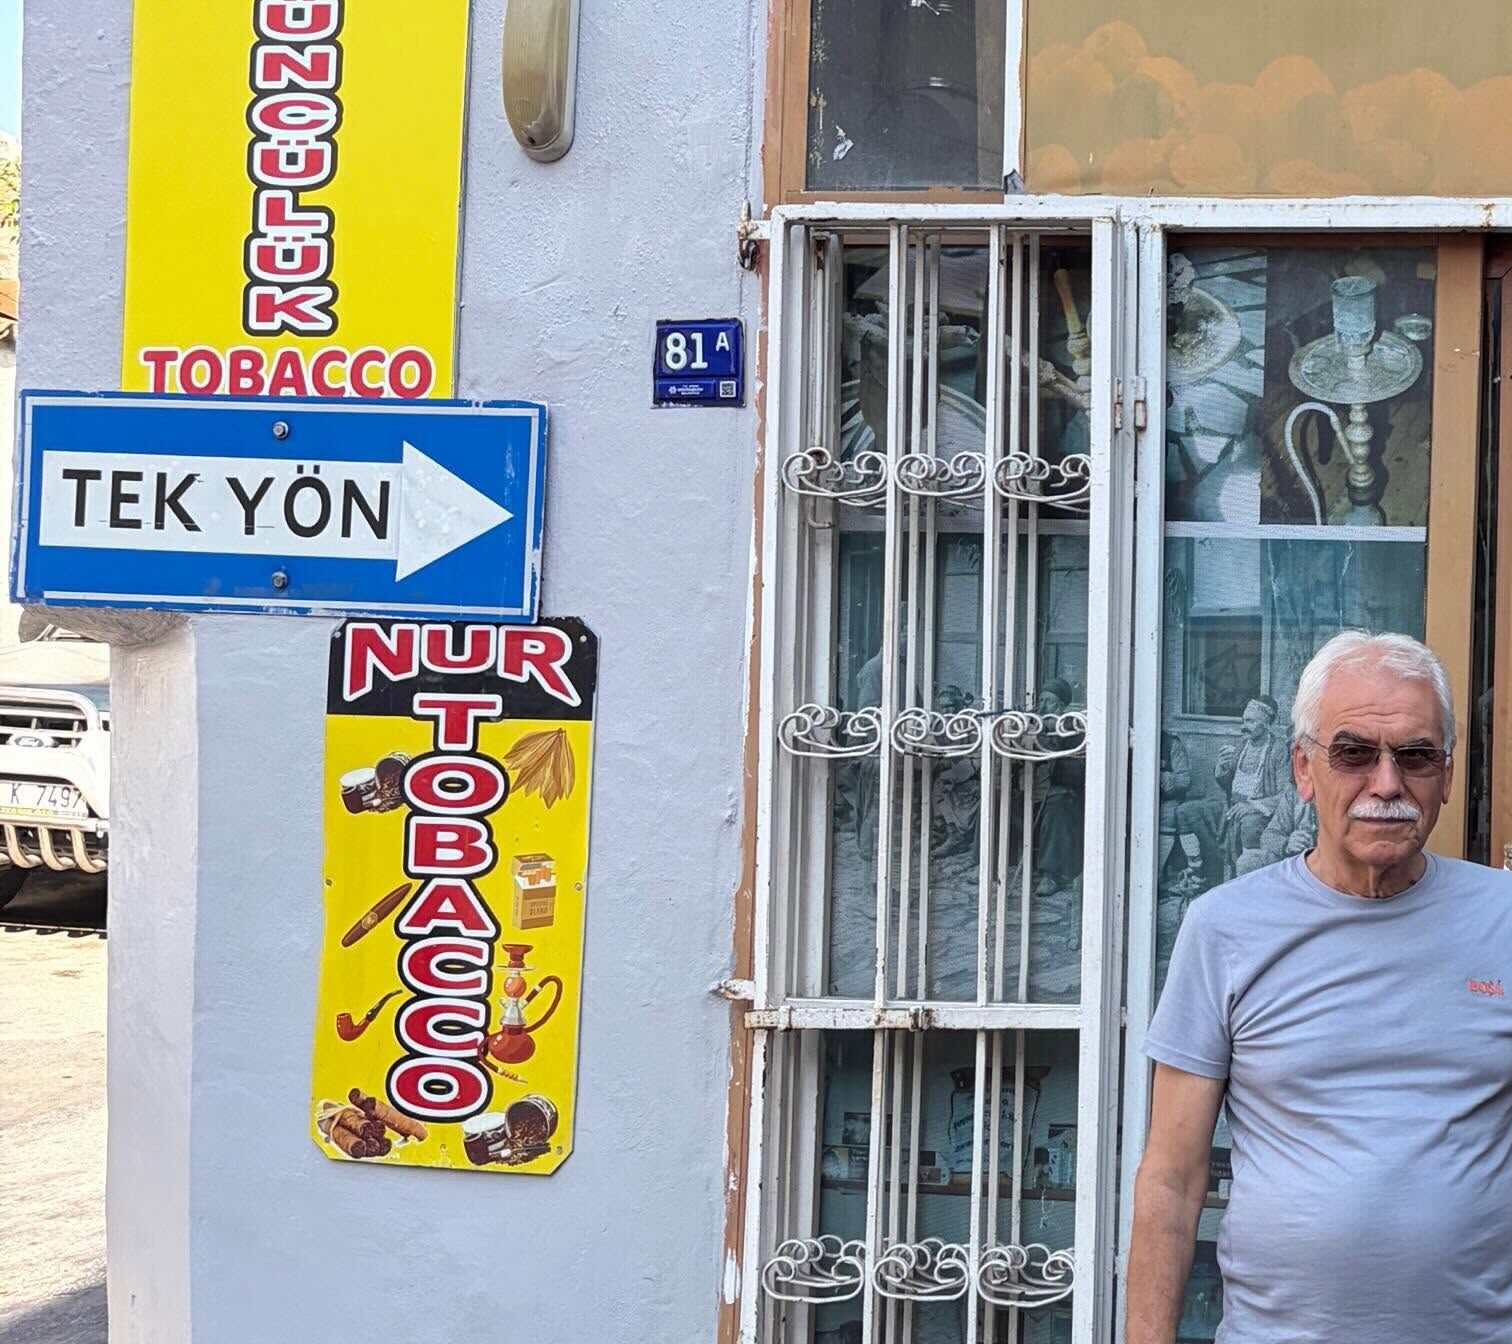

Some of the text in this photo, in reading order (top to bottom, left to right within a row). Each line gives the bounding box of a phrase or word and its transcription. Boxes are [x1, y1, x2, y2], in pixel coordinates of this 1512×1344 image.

[141, 346, 436, 400] TOBACCO
[665, 331, 708, 370] 81
[62, 464, 391, 541] TEK YÖN
[343, 622, 582, 707] NUR
[388, 692, 508, 1119] TOBACCO
